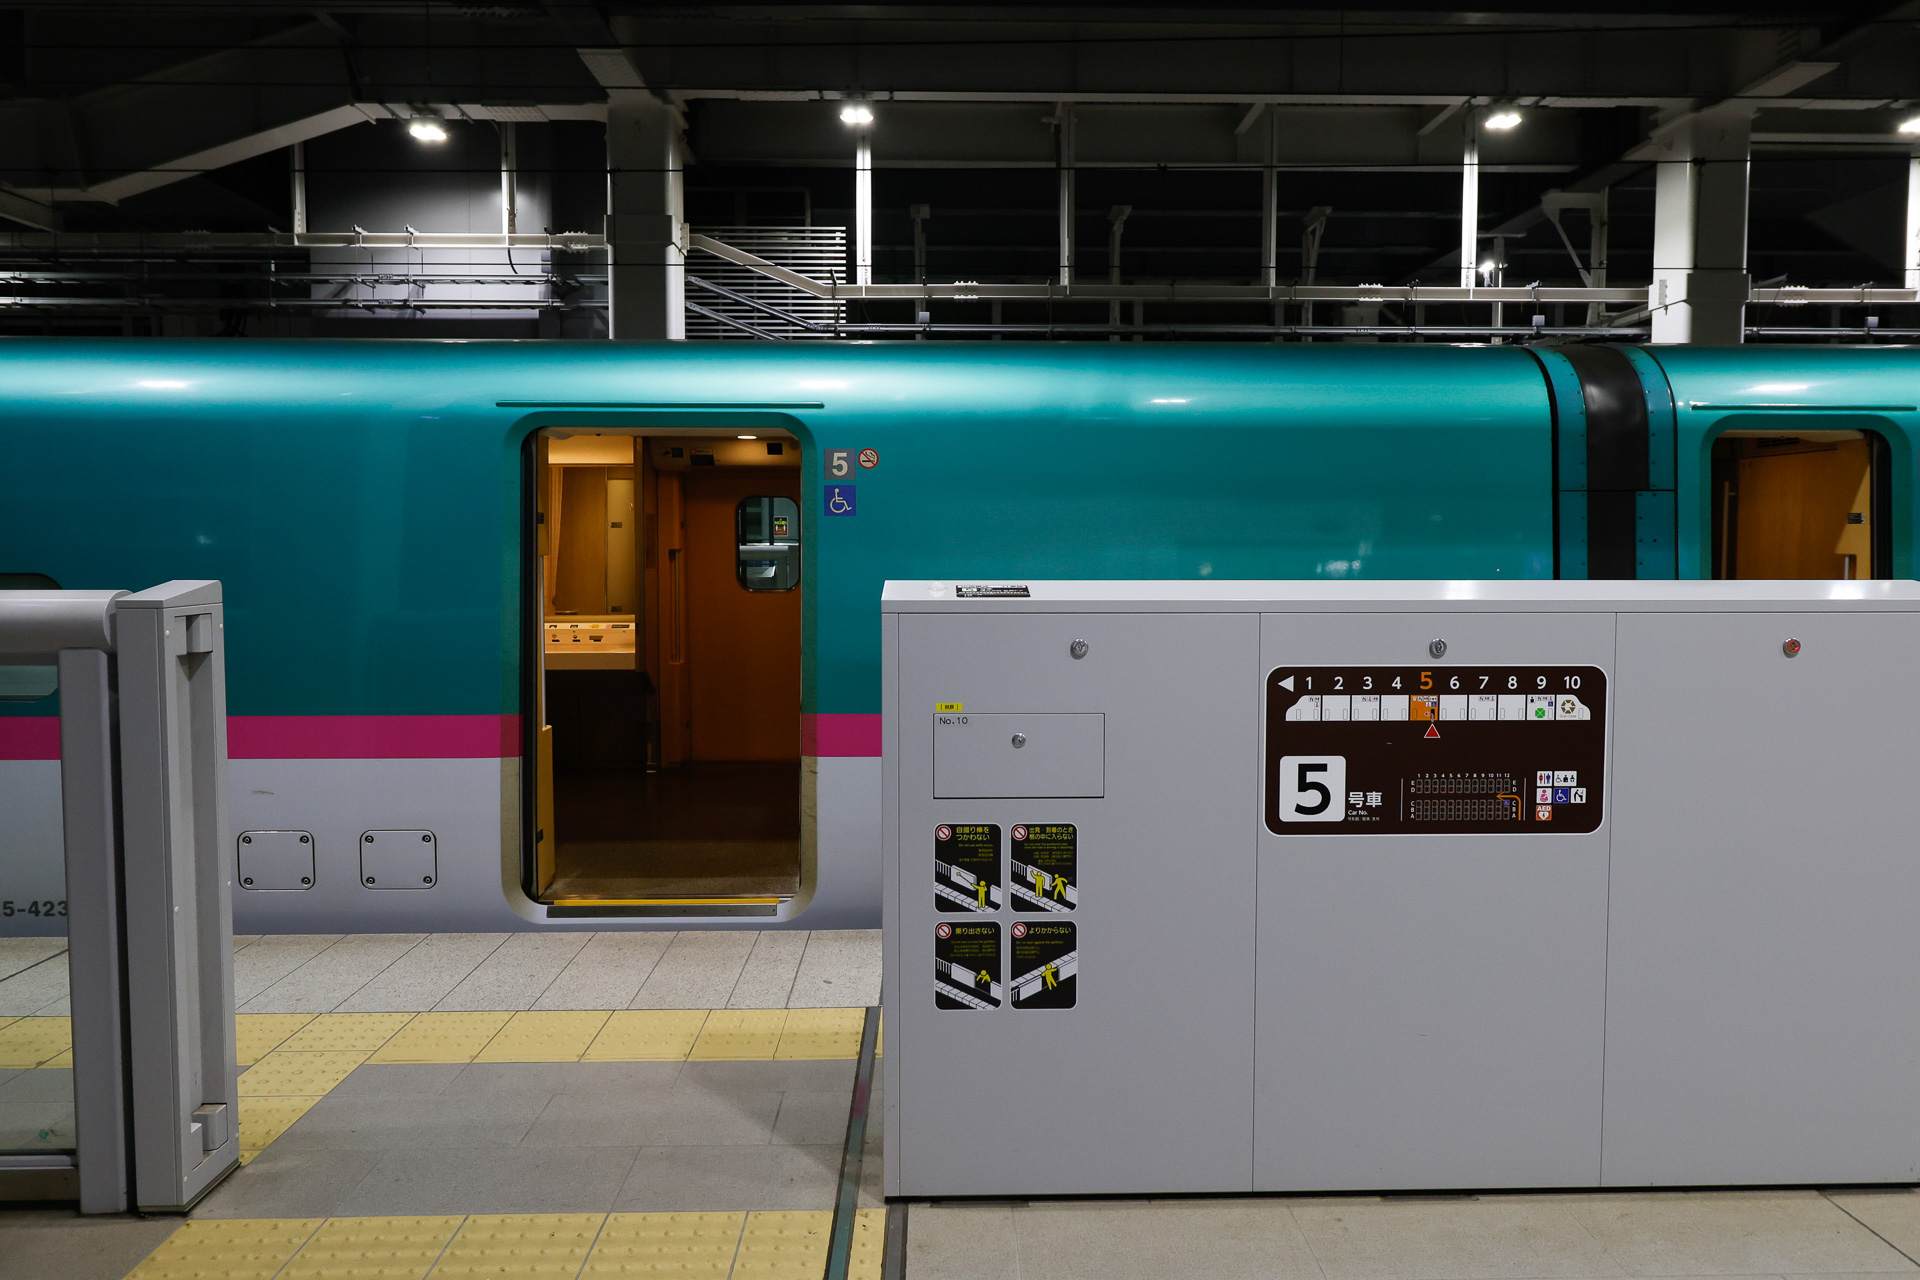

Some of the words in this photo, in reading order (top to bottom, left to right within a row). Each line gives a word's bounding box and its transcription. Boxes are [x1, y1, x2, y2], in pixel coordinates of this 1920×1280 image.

[832, 452, 848, 476] 5
[1306, 676, 1312, 690] 1
[1334, 676, 1344, 690] 2
[1363, 676, 1373, 690] 3
[1391, 676, 1402, 690] 4
[1420, 672, 1433, 690] 5
[1450, 676, 1460, 690] 6
[1479, 676, 1489, 690] 7
[1507, 676, 1517, 690] 8
[1536, 676, 1546, 690] 9
[1563, 676, 1581, 690] 10
[939, 716, 969, 725] No.10
[1294, 763, 1331, 815] 5
[1348, 791, 1383, 808] 号車
[0, 900, 68, 917] 5-423
[955, 927, 995, 935] 乗り出さない
[1028, 926, 1072, 935] よりかからない
